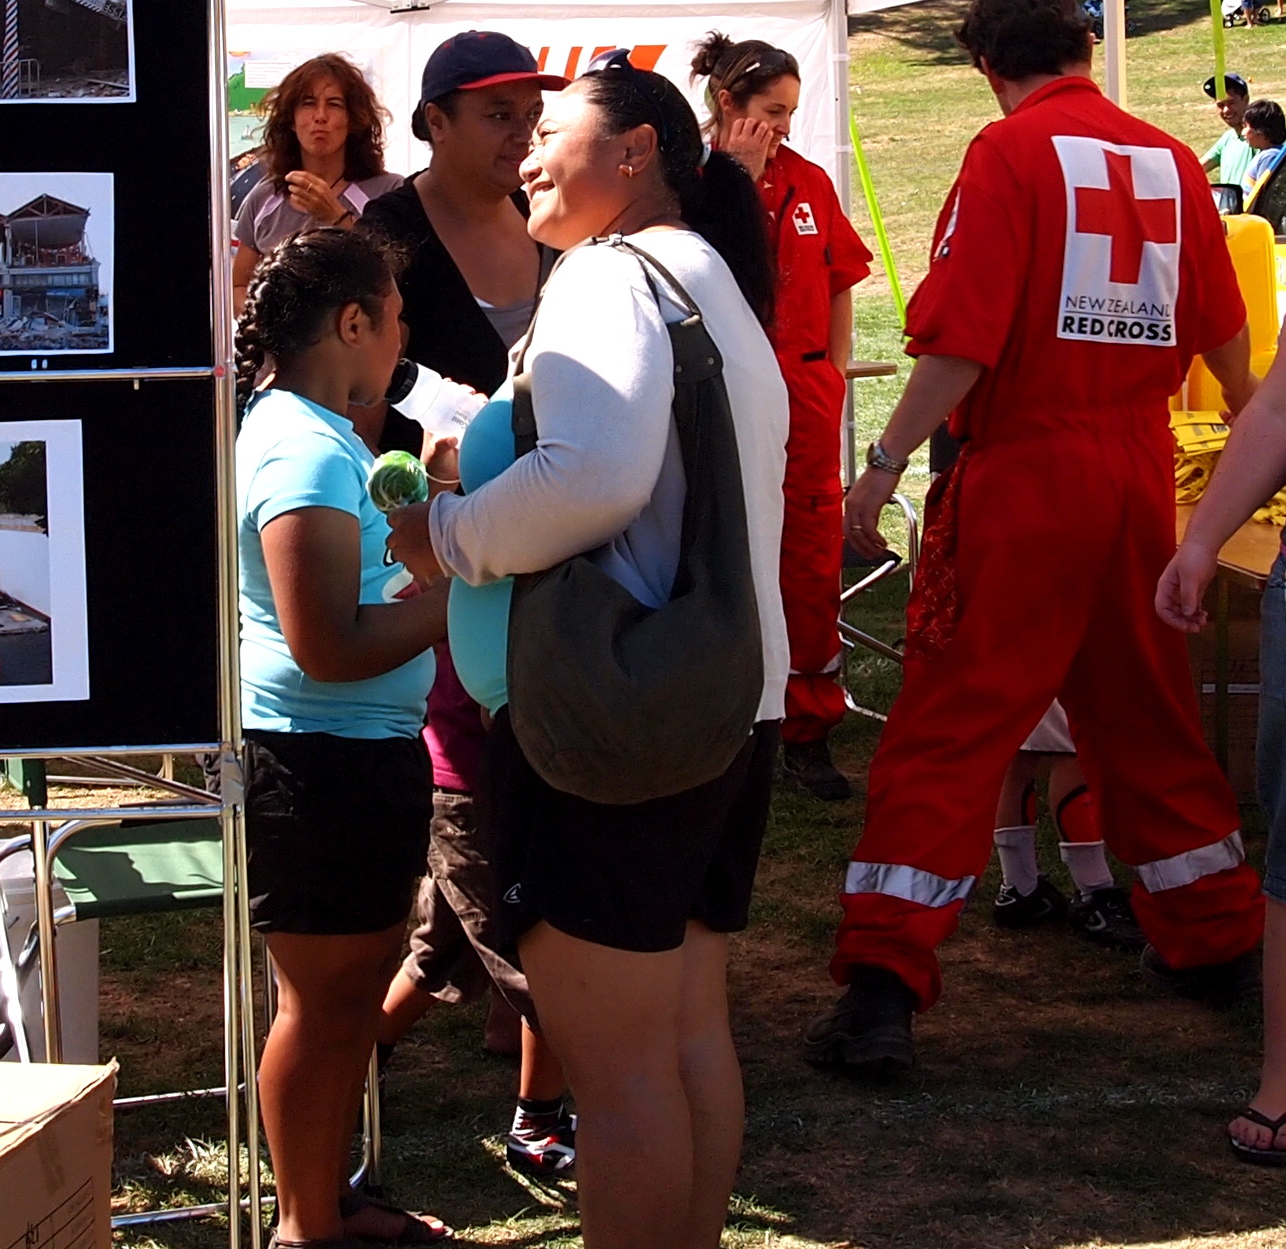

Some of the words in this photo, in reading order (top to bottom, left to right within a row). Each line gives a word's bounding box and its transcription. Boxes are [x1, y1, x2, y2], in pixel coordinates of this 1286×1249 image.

[1065, 295, 1106, 311] NEW
[1062, 315, 1105, 335] RED
[1107, 319, 1172, 342] CROSS
